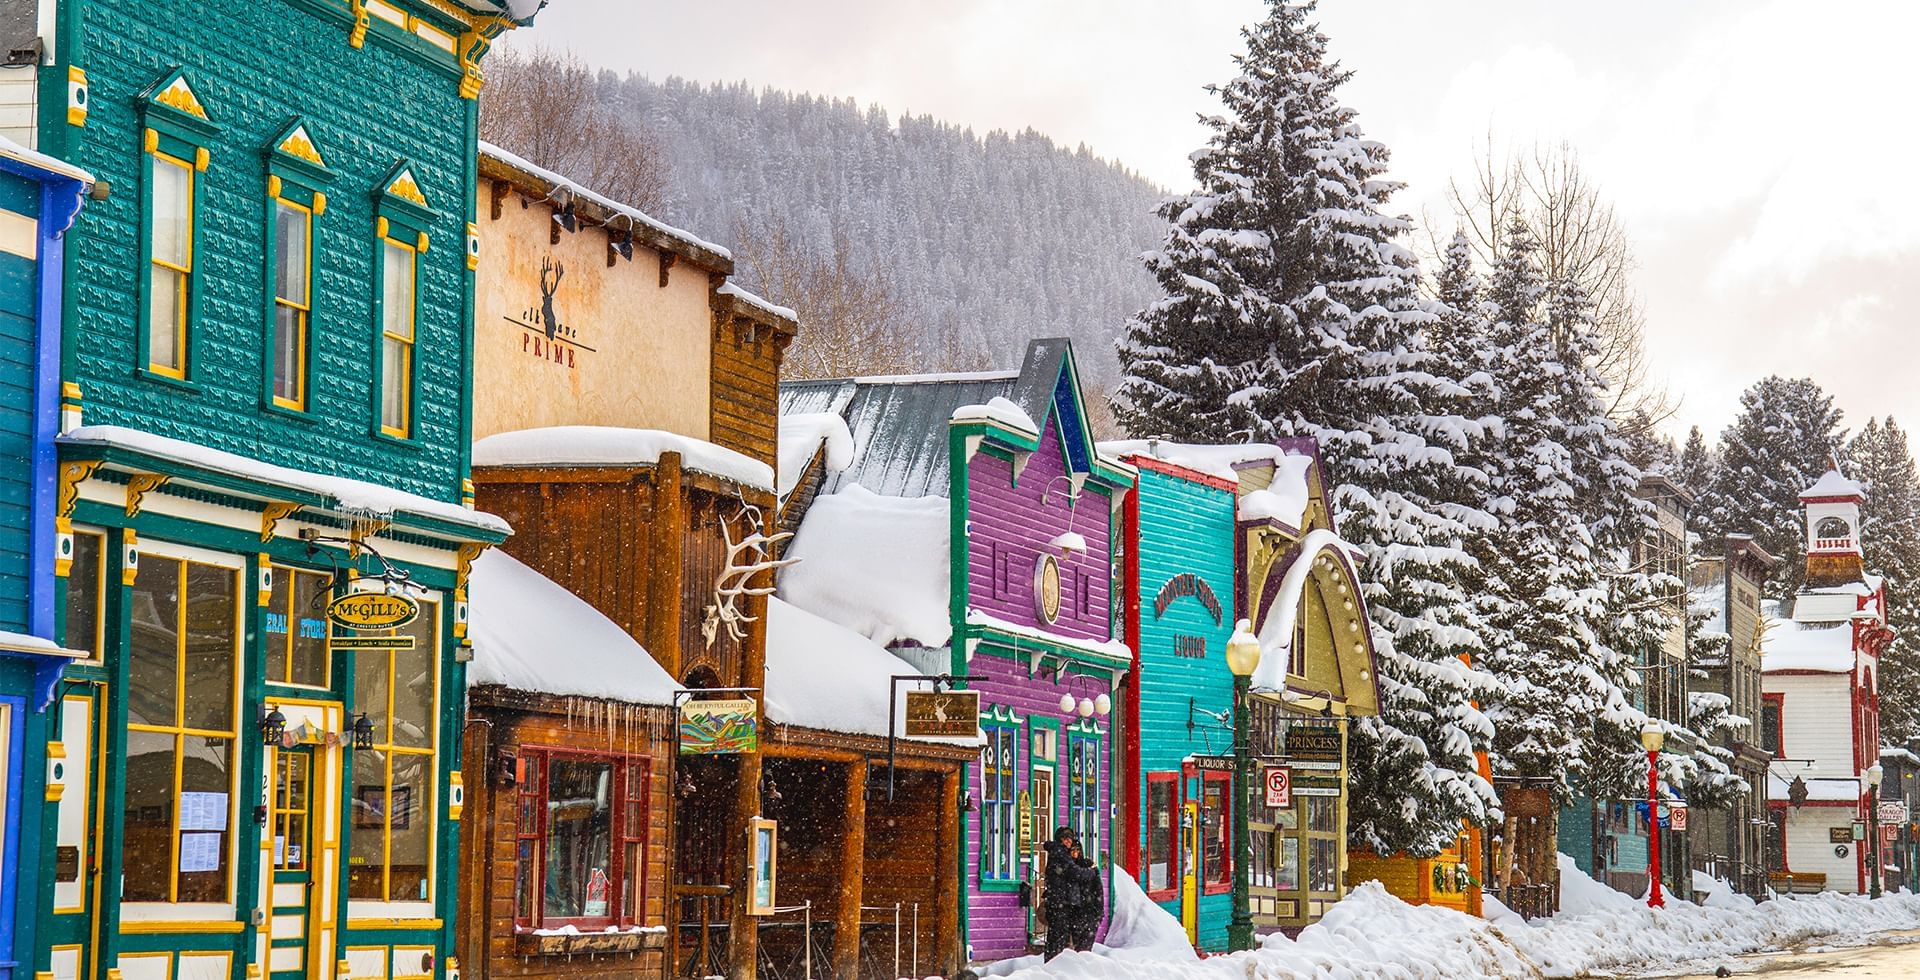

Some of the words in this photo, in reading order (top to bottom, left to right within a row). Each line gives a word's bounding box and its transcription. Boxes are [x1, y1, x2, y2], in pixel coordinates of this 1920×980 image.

[523, 307, 540, 324] elk
[558, 324, 577, 338] ave
[523, 332, 575, 369] PRIME
[1153, 571, 1195, 621] MOUNTAIN
[1196, 575, 1223, 628] SPIRITS
[300, 618, 326, 638] STORE
[1174, 633, 1205, 658] LIQUOR
[1289, 736, 1338, 749] PRINCESS
[1198, 758, 1226, 769] LIQUOR
